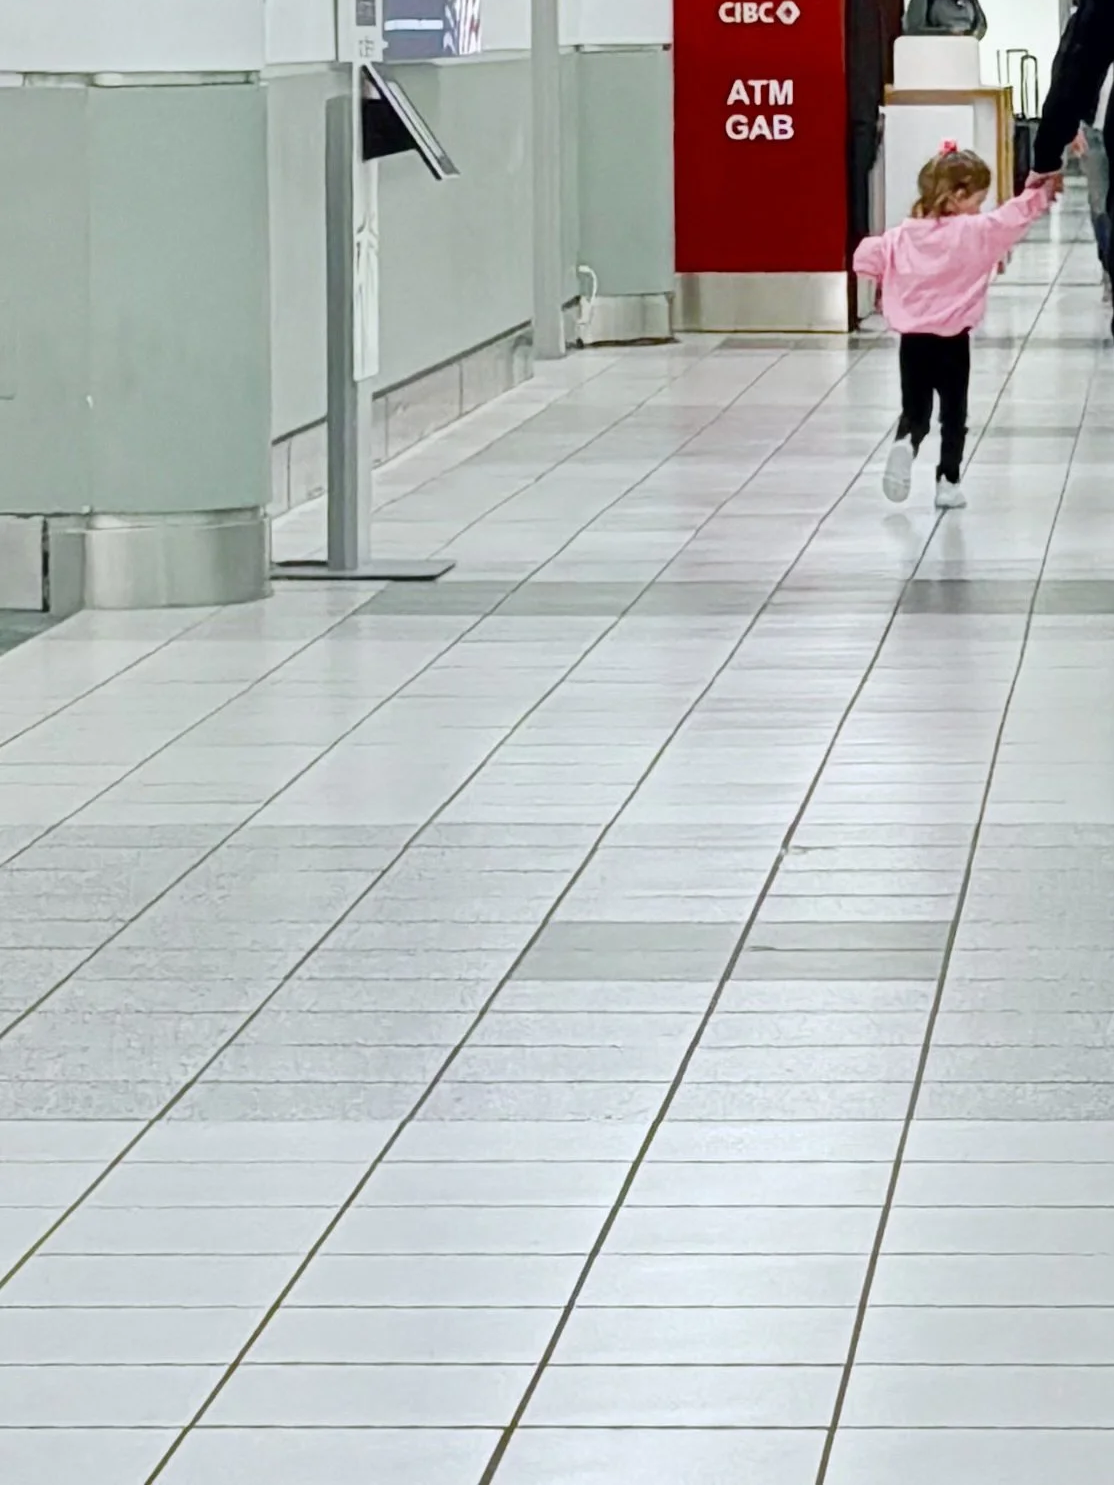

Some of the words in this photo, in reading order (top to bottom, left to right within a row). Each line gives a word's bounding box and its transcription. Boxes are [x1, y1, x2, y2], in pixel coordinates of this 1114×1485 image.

[718, 1, 775, 23] CIBC
[726, 79, 794, 105] ATM
[725, 114, 794, 140] GAB
